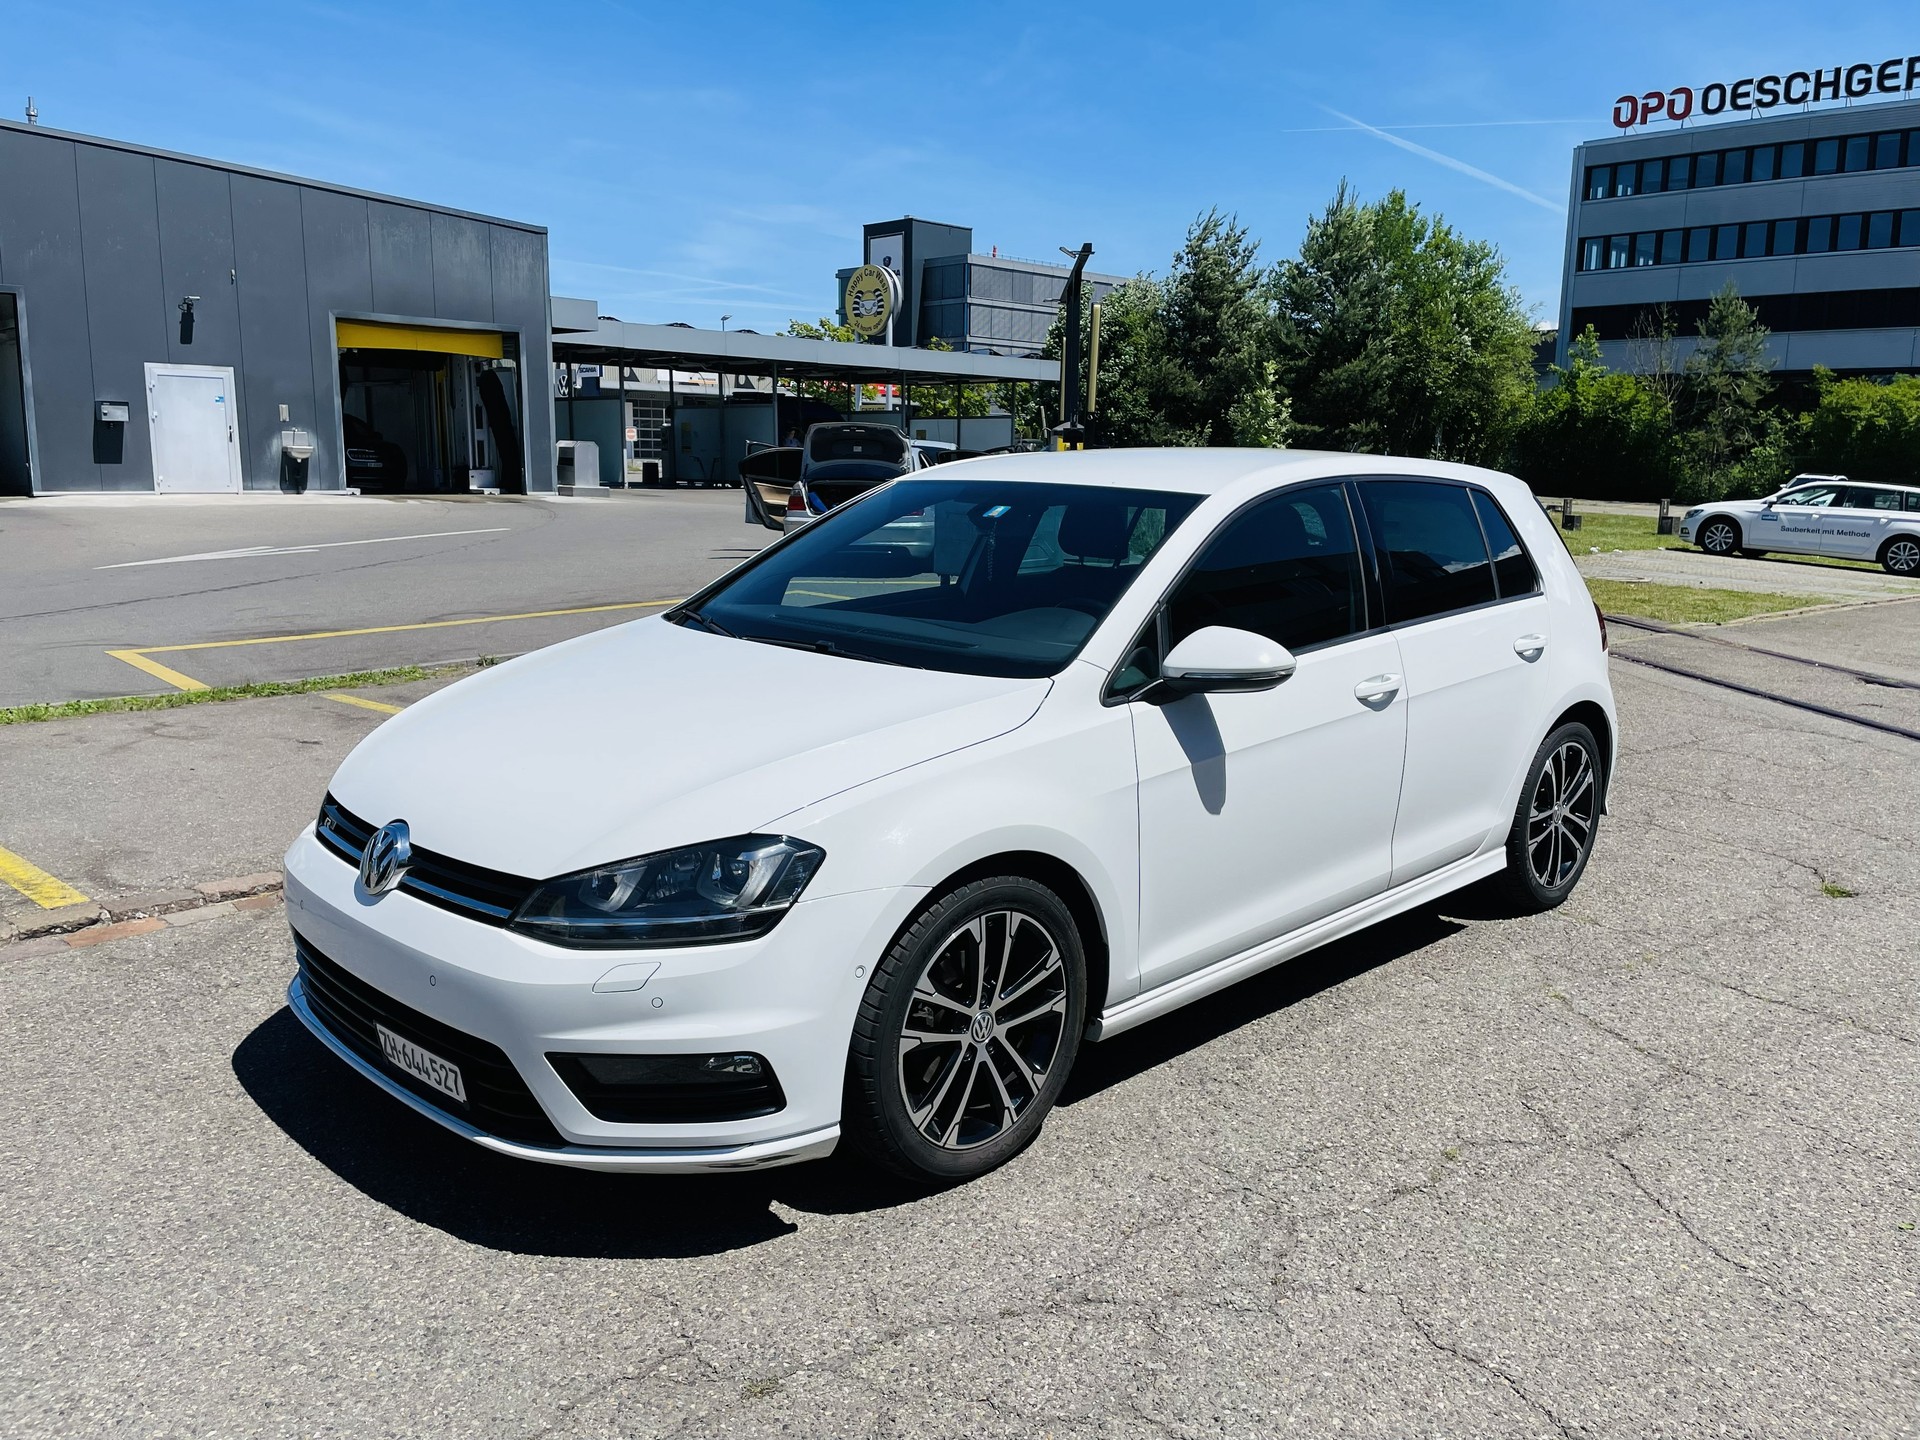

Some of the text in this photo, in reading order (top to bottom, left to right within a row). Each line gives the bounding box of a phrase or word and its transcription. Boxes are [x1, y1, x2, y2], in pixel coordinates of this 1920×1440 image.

[1613, 87, 1694, 128] OPO
[848, 268, 888, 297] Happy Car Wash
[860, 322, 873, 332] hours
[1780, 525, 1871, 538] Sauberkeit mit Methode
